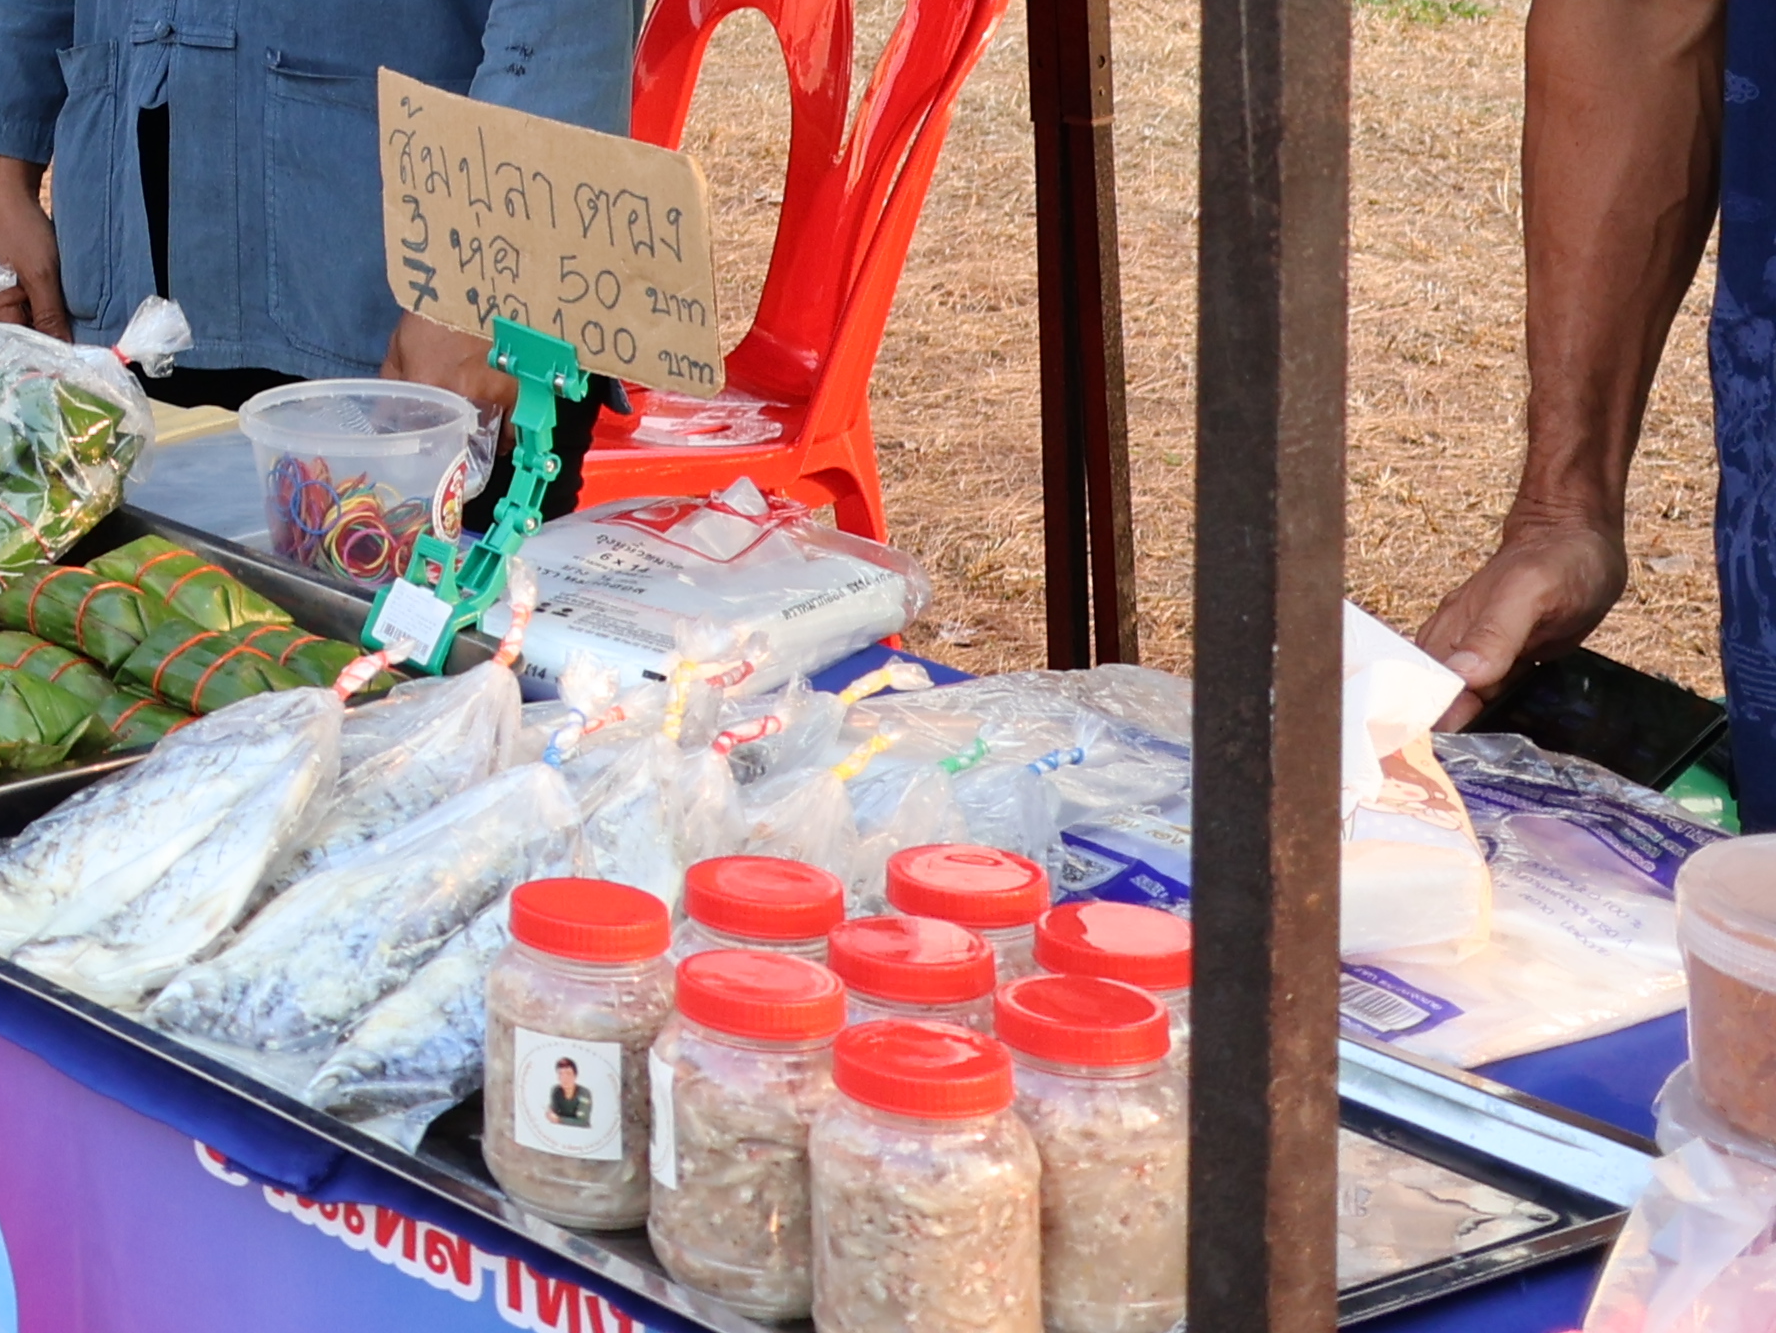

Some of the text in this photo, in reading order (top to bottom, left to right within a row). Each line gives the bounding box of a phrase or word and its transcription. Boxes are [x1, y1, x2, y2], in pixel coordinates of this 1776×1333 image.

[402, 194, 429, 254] 3
[559, 255, 622, 311] 50
[645, 284, 707, 329] บาท
[403, 259, 440, 312] 7
[658, 348, 715, 385] บาท
